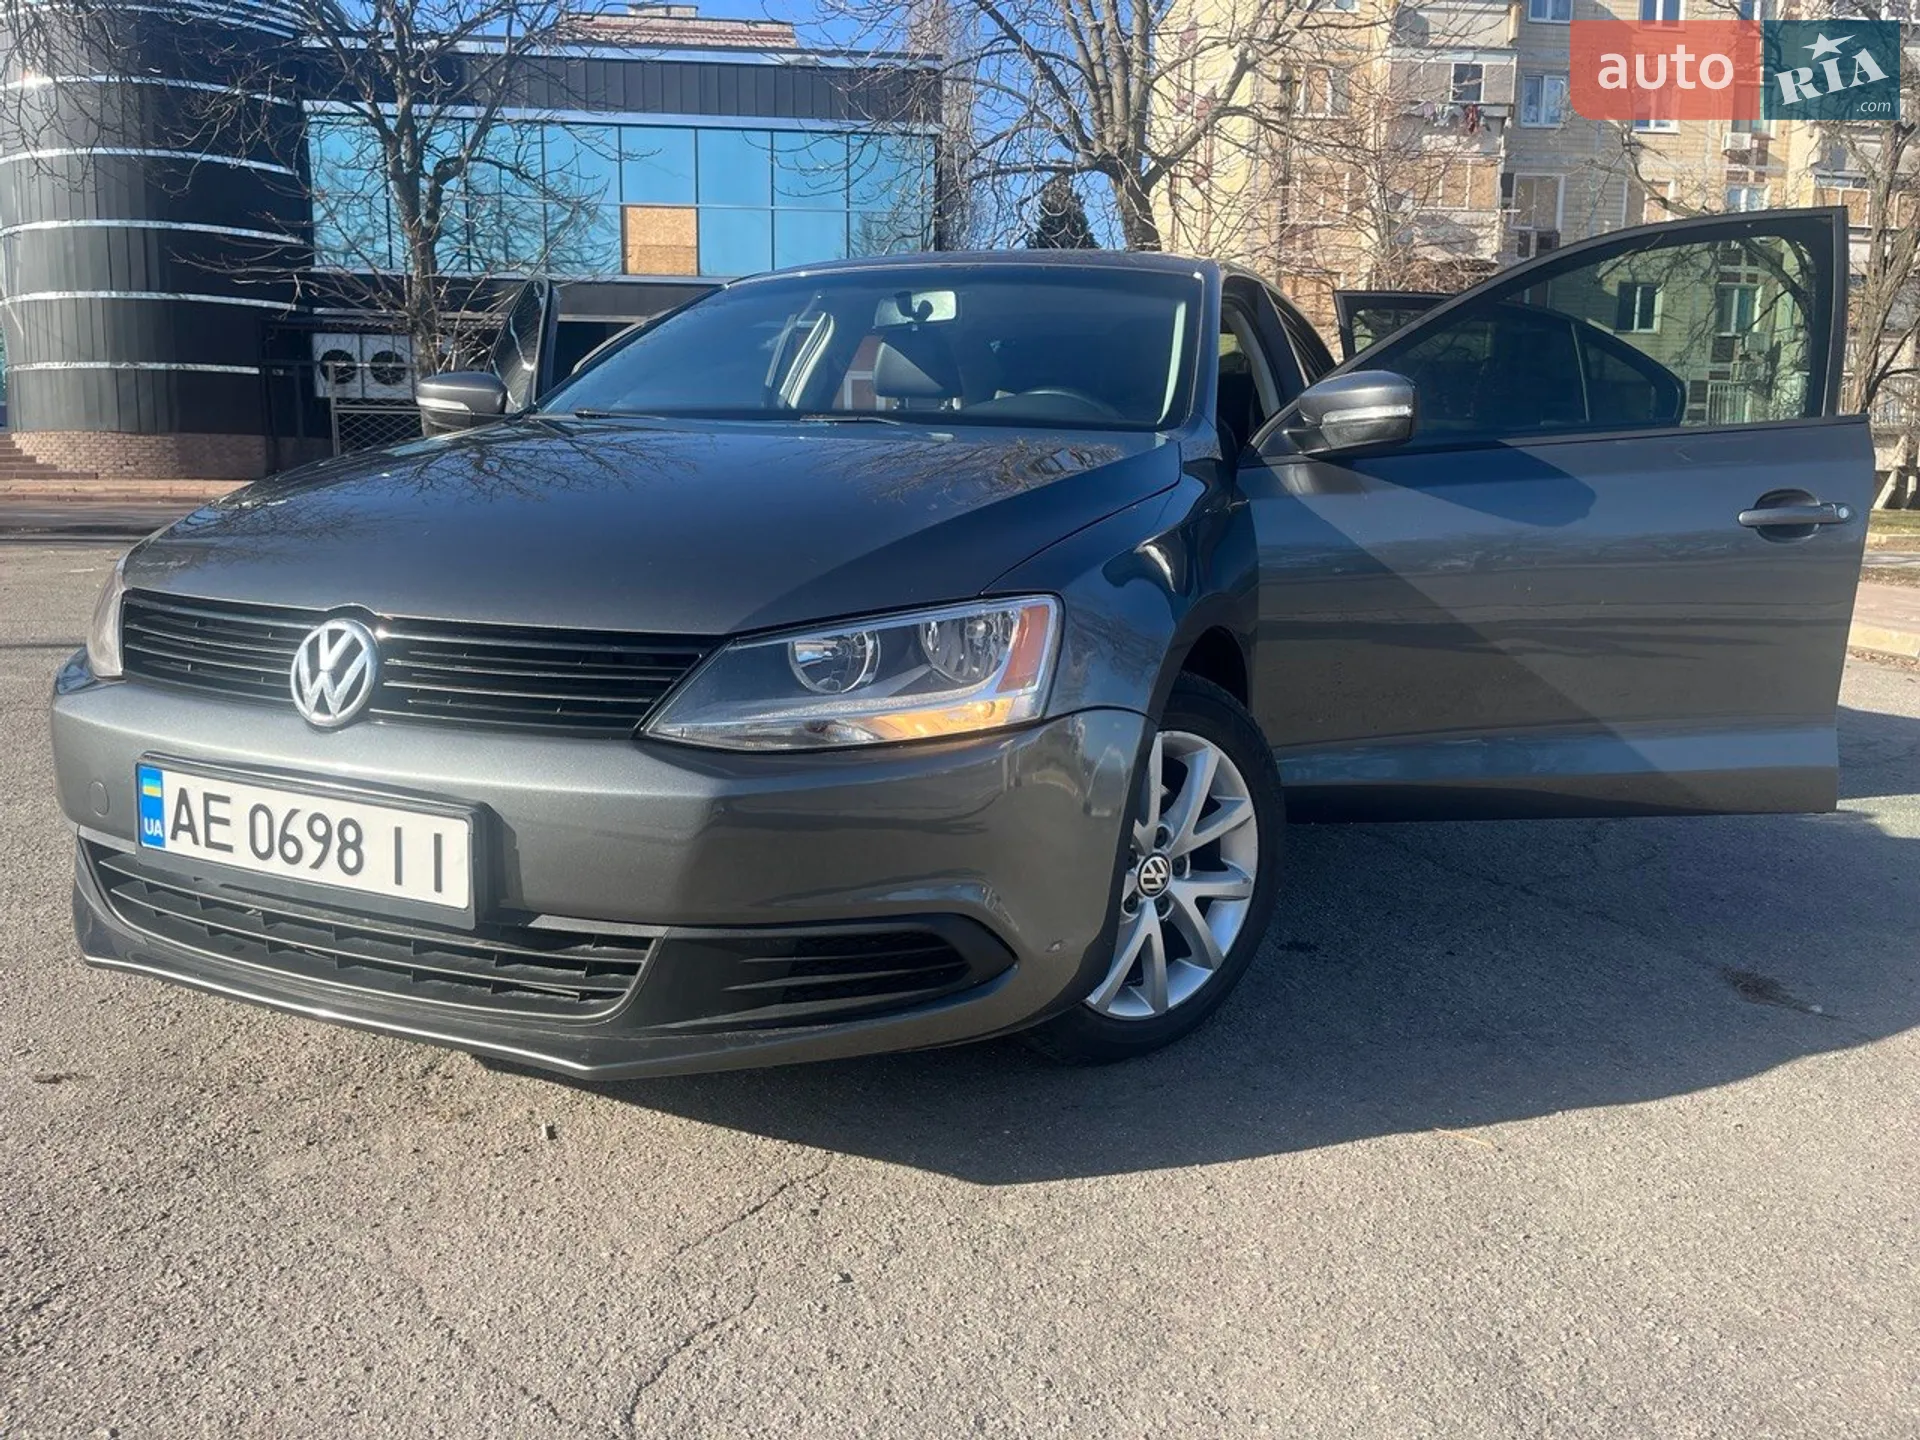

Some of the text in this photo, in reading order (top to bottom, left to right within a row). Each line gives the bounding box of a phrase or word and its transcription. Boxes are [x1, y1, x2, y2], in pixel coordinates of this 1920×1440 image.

[144, 817, 163, 838] UA
[170, 787, 234, 853] AE
[249, 803, 364, 876] 0698
